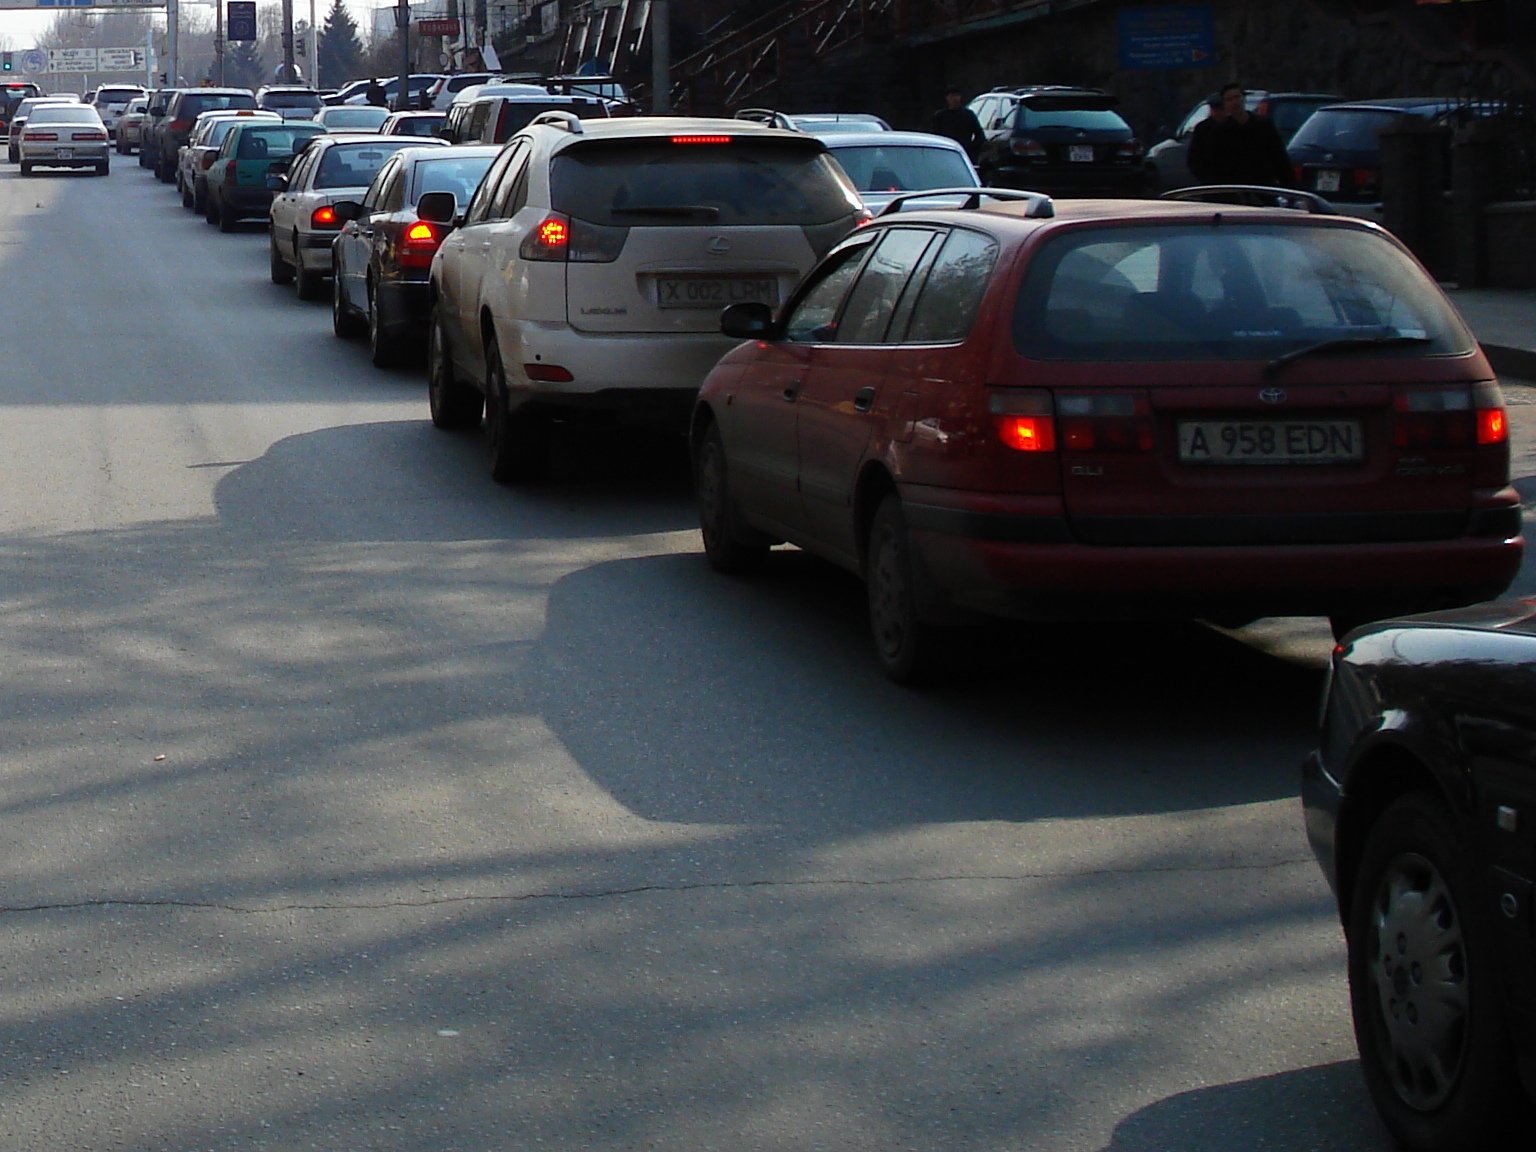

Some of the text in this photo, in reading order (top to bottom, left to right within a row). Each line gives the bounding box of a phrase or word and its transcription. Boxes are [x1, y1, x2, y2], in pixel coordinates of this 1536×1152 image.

[687, 281, 722, 300] 002
[1190, 424, 1353, 456] A 958 EDN
